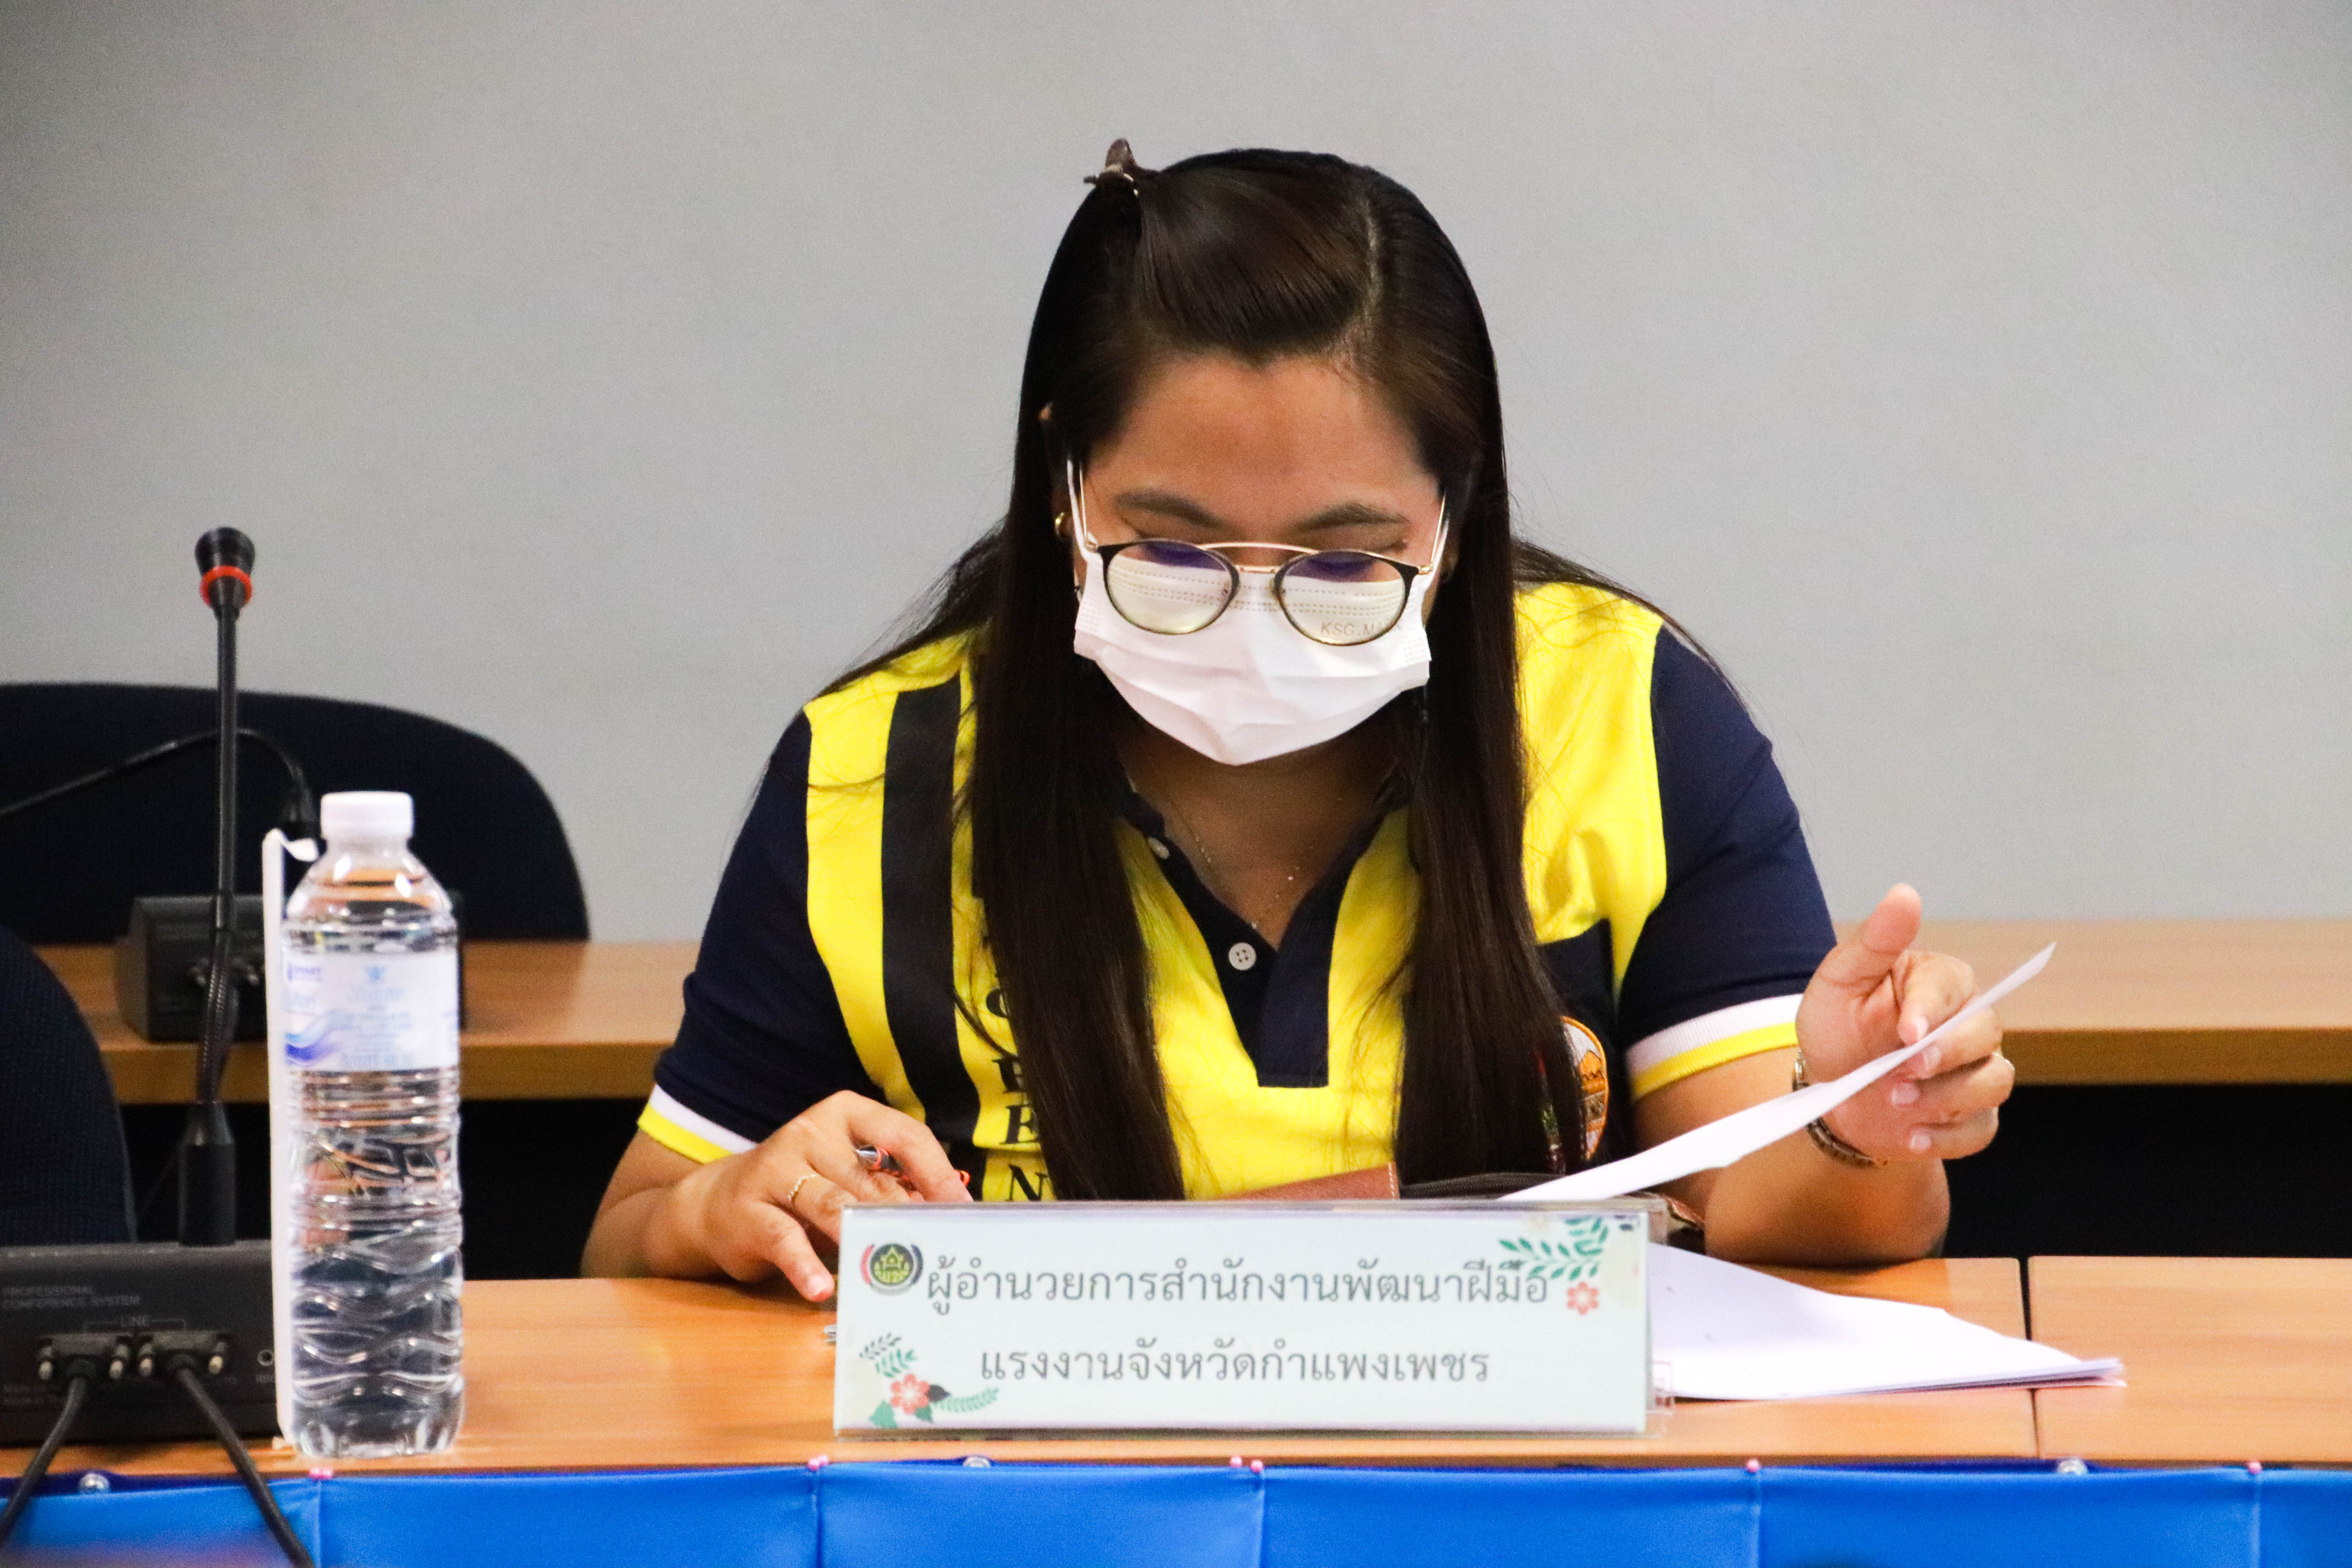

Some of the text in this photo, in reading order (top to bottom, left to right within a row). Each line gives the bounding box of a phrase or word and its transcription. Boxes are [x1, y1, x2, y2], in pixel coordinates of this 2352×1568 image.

[927, 1255, 1547, 1316] ผู้อำนวยการสำนักงานพัฒนาฝีมือ
[91, 1295, 140, 1306] SYSTEM
[120, 1315, 150, 1328] LINE
[981, 1338, 1490, 1380] แรงงานจังหวัดกำแพงเพชร
